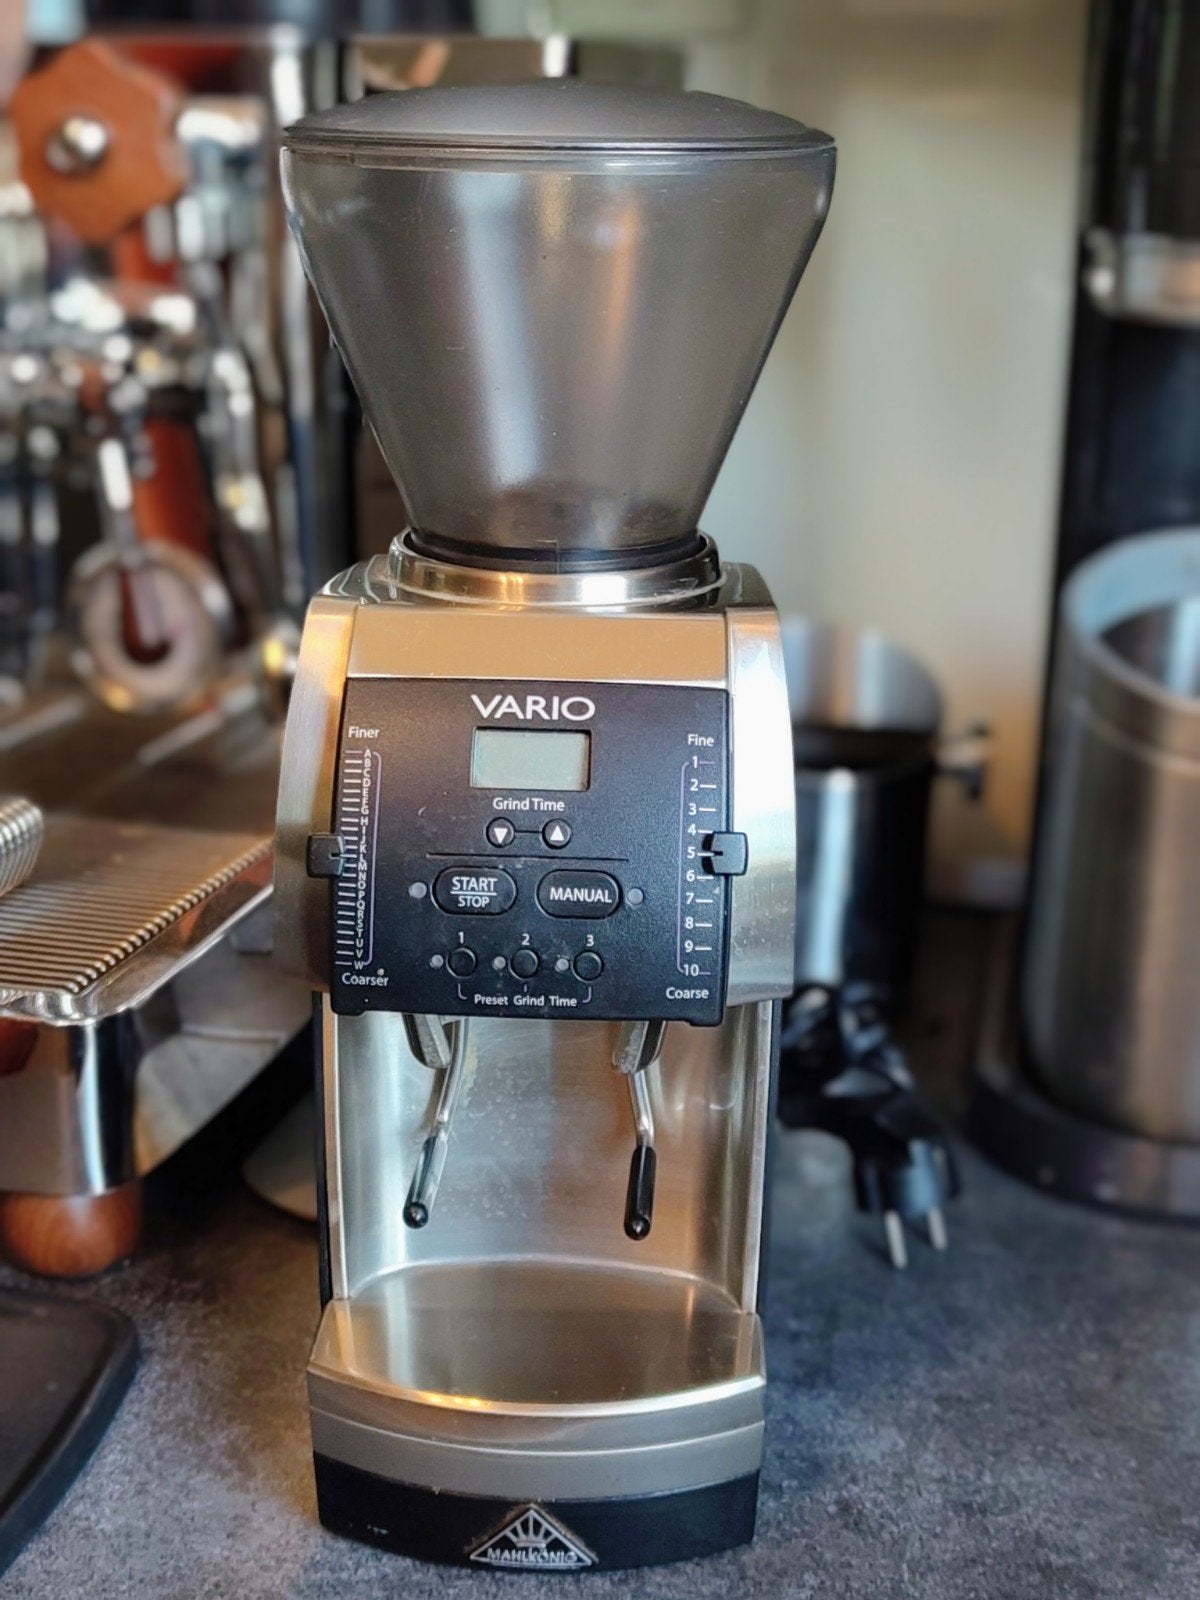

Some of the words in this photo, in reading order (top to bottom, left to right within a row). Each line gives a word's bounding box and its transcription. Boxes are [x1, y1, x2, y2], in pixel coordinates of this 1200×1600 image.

[470, 694, 596, 721] VARIO
[348, 726, 380, 738] Finer
[687, 734, 715, 746] Fine
[364, 749, 372, 758] A
[364, 758, 372, 767] B
[691, 756, 698, 769] 1
[363, 768, 371, 777] C
[362, 778, 371, 787] D
[690, 779, 699, 792] 2
[362, 788, 370, 797] E
[493, 797, 529, 810] Grind
[531, 798, 565, 811] Time
[688, 803, 697, 815] 3
[360, 806, 369, 815] G
[360, 816, 369, 826] H
[687, 823, 697, 836] 4
[359, 844, 367, 853] K
[686, 846, 696, 859] 5
[357, 861, 367, 871] M
[358, 871, 366, 880] N
[686, 870, 695, 882] 6
[357, 880, 366, 889] O
[452, 876, 498, 891] START
[358, 890, 365, 899] P
[549, 887, 613, 903] MANUAL
[685, 892, 694, 905] 7
[356, 900, 365, 910] Q
[458, 896, 490, 908] STOP
[357, 910, 364, 919] R
[357, 919, 363, 928] S
[684, 917, 694, 929] 8
[356, 928, 364, 937] T
[458, 931, 465, 944] 1
[356, 939, 363, 947] U
[521, 933, 530, 946] 2
[586, 935, 595, 947] 3
[684, 940, 694, 953] 9
[355, 949, 363, 958] V
[354, 960, 364, 970] W
[683, 964, 699, 977] 10
[342, 973, 389, 986] Coarser
[665, 987, 710, 1000] Coarse
[474, 994, 508, 1005] Preset
[513, 995, 545, 1006] Grind
[549, 996, 577, 1007] Time
